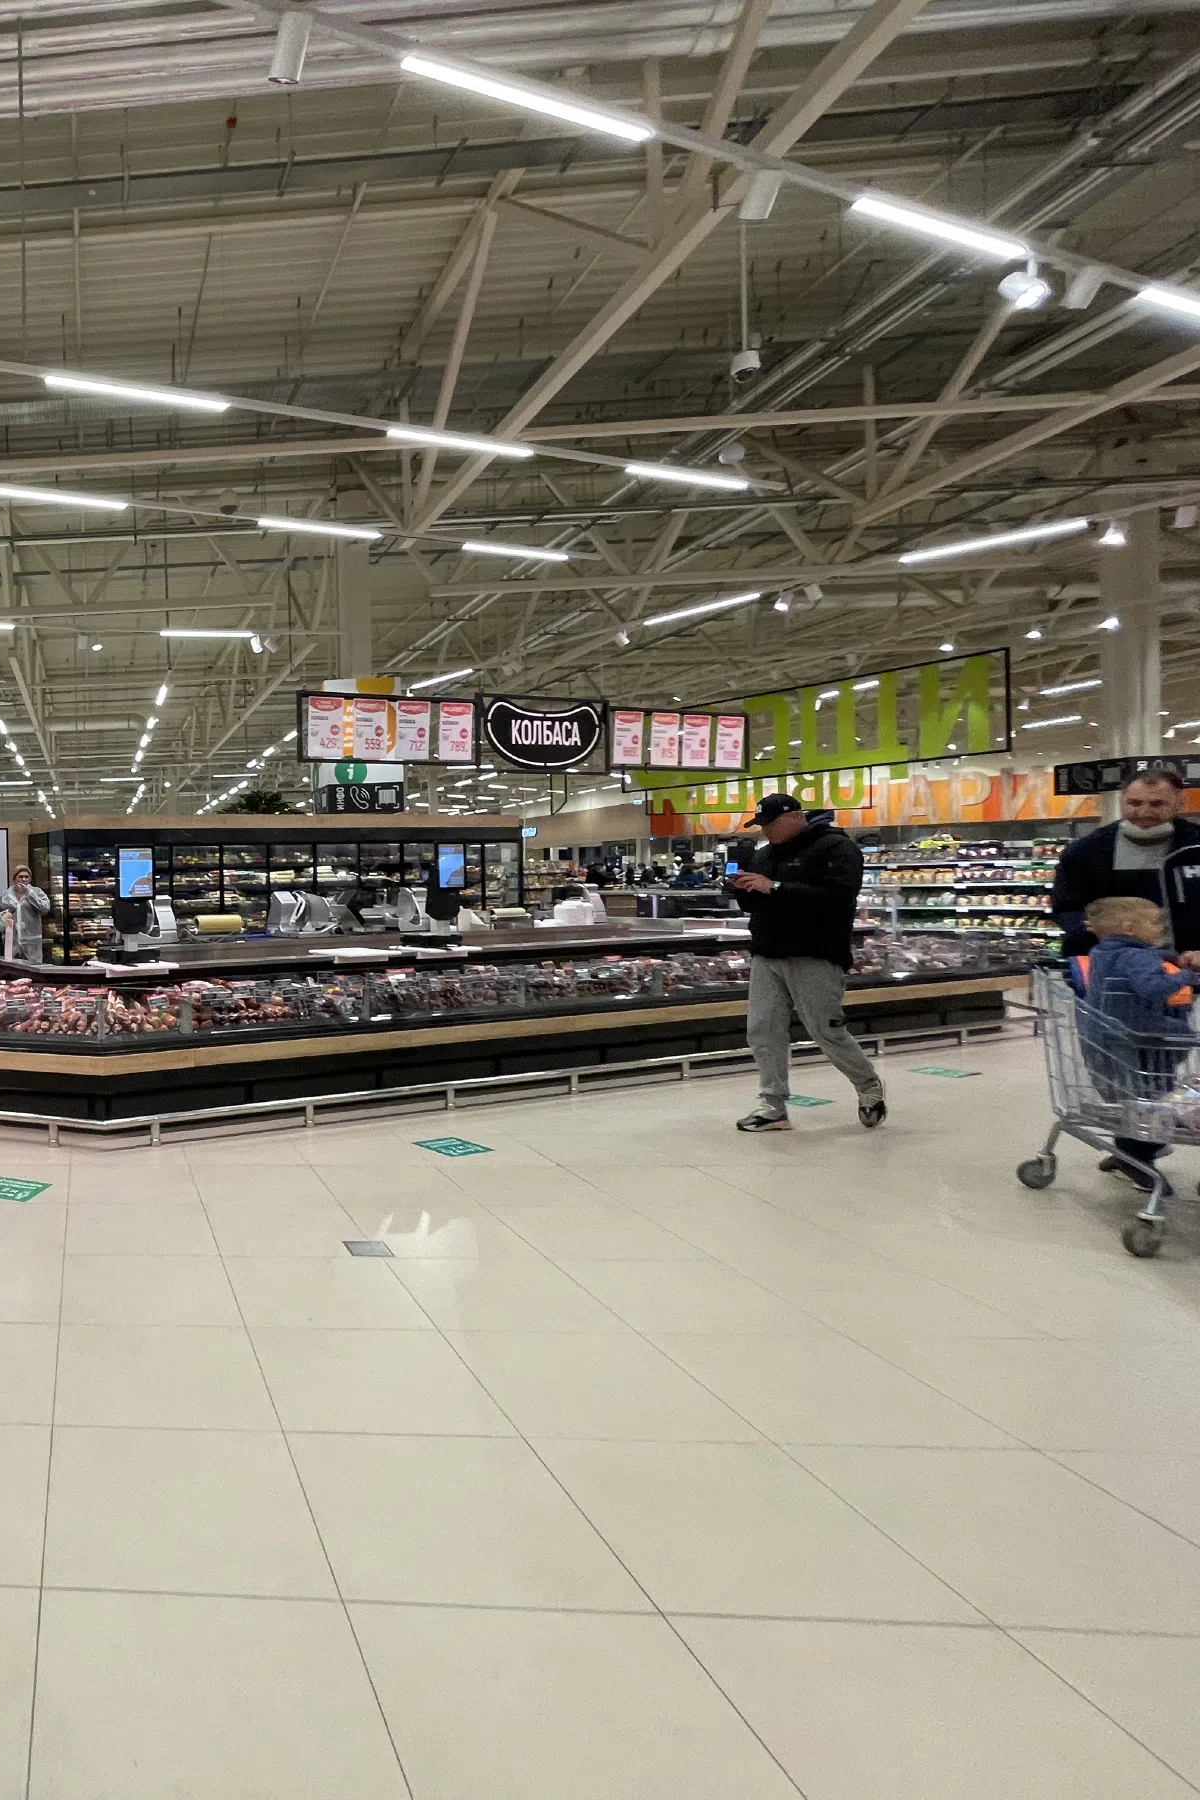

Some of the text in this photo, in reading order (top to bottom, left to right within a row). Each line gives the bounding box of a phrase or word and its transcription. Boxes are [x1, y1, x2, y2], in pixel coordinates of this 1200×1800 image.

[364, 738, 381, 750] 559
[511, 719, 582, 747] КОЛБАСА
[336, 786, 345, 811] ИНФО
